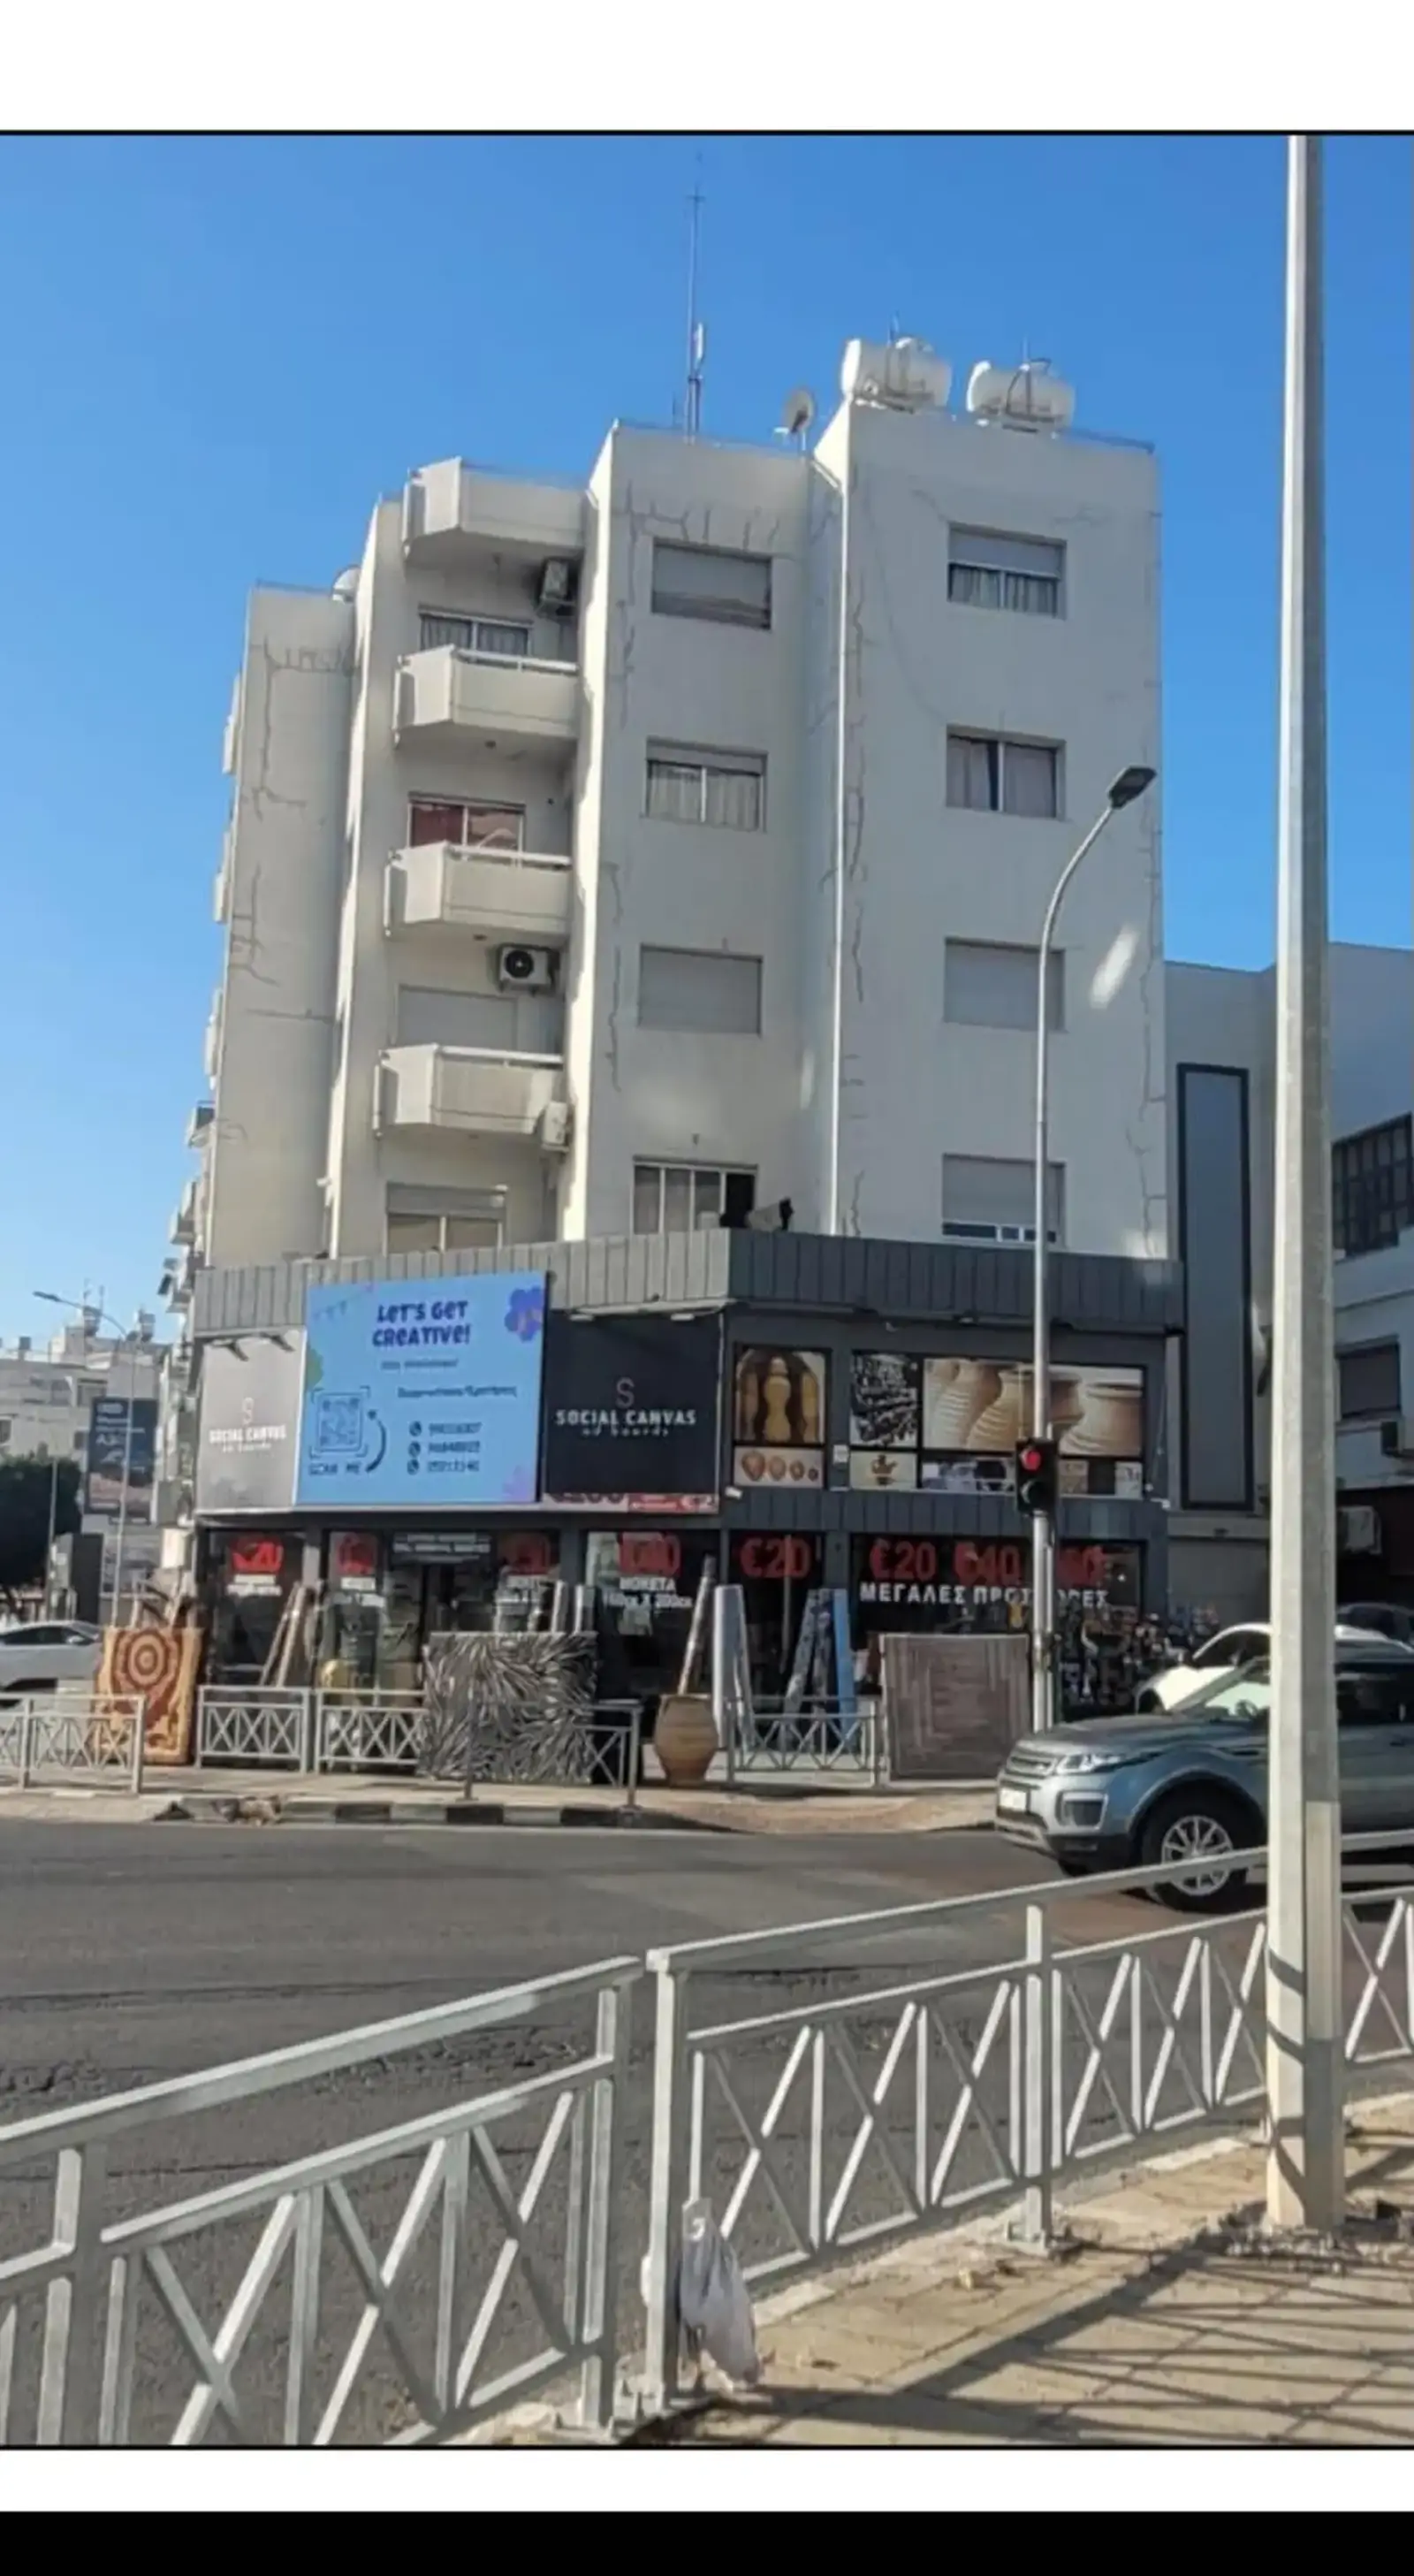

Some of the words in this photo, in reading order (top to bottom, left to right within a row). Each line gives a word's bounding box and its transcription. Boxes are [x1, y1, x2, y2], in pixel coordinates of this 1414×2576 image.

[556, 1409, 619, 1426] SOCIAL
[626, 1409, 696, 1426] CANVAS
[870, 1537, 937, 1581] €20
[859, 1581, 967, 1605] ΜΕΓΑΛΕΣ
